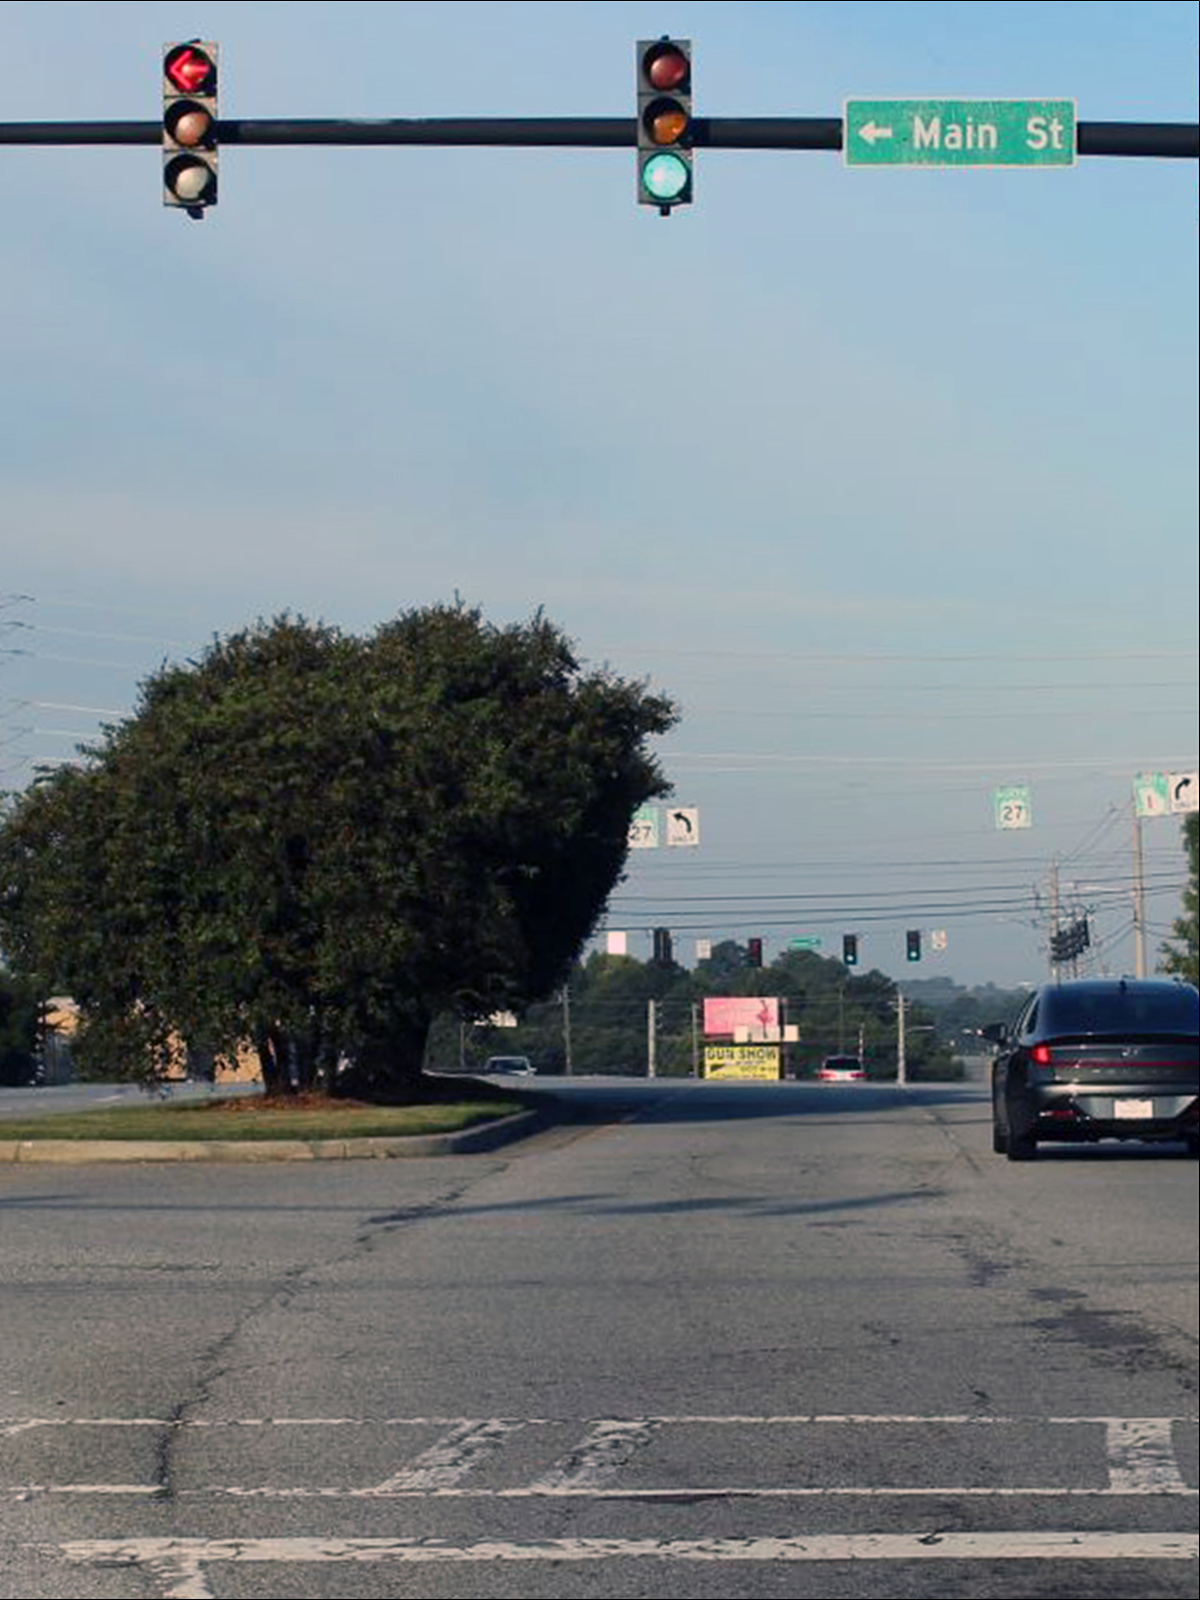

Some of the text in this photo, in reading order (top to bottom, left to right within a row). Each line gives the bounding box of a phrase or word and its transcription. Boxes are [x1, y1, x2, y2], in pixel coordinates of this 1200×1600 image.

[913, 116, 1064, 150] Main St
[1002, 805, 1023, 821] 27
[629, 825, 652, 842] 27
[707, 1048, 735, 1060] GUN
